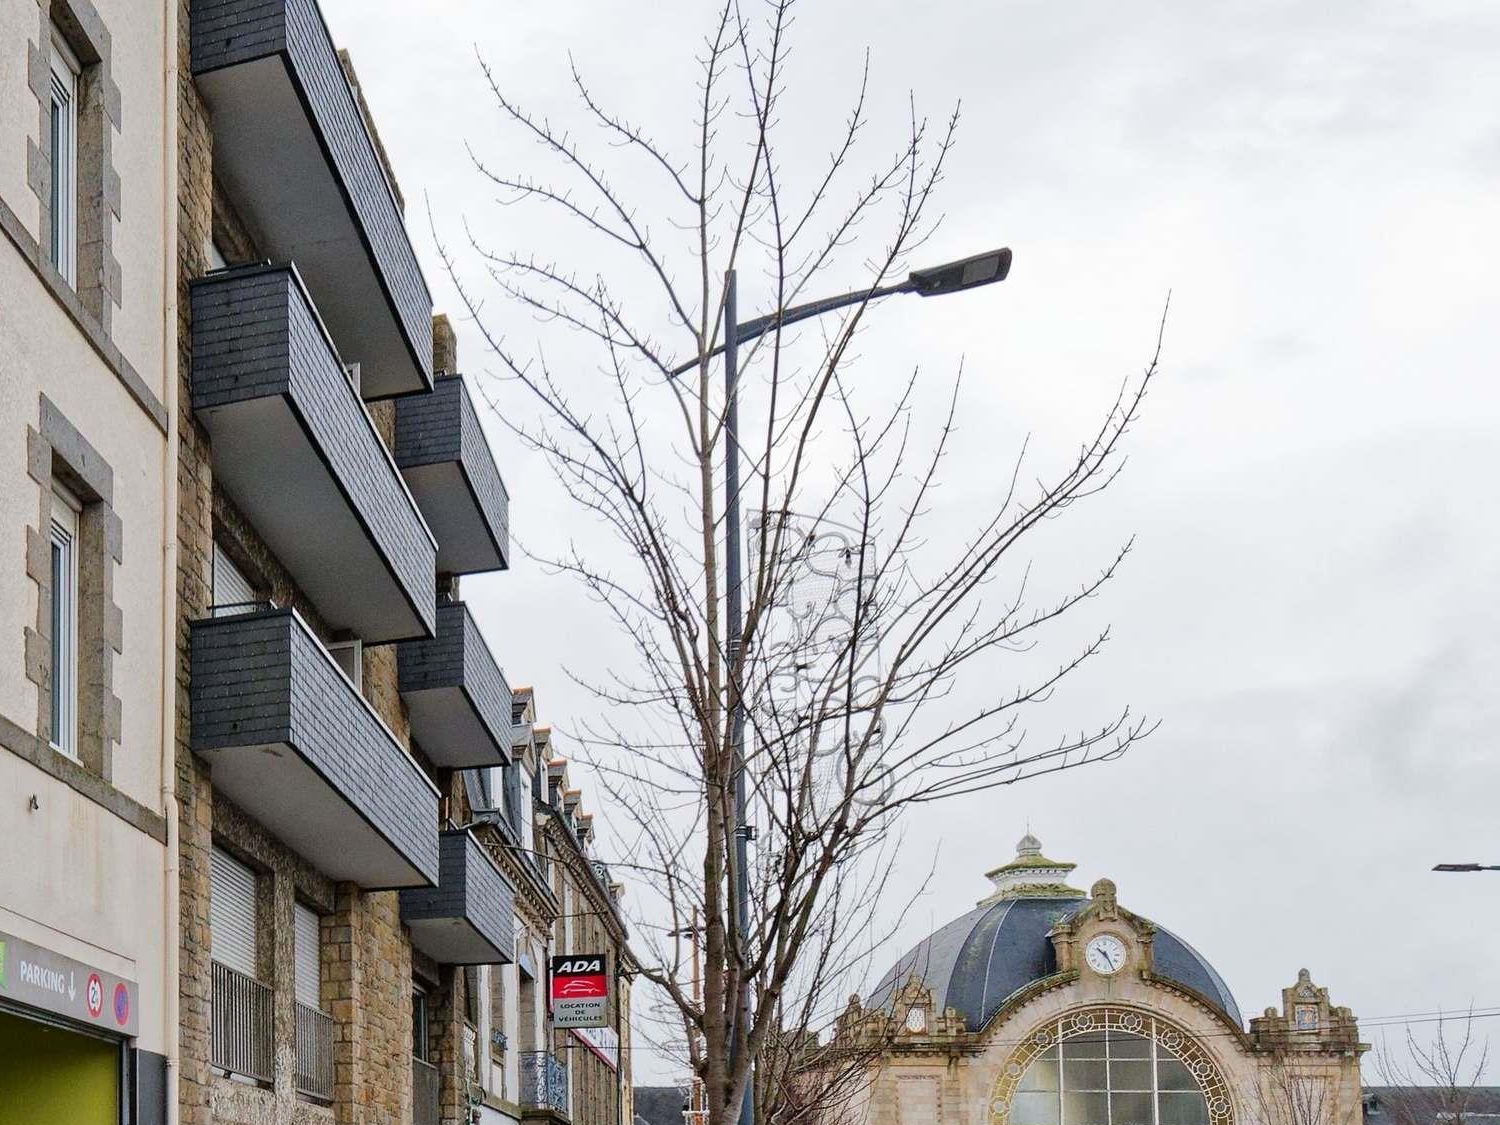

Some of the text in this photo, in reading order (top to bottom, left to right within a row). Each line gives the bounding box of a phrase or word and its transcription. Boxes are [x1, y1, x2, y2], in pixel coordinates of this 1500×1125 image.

[557, 960, 601, 973] ADA
[20, 960, 65, 995] PARKING
[560, 1002, 601, 1010] LOCATION
[558, 1014, 602, 1022] VÉHICULES
